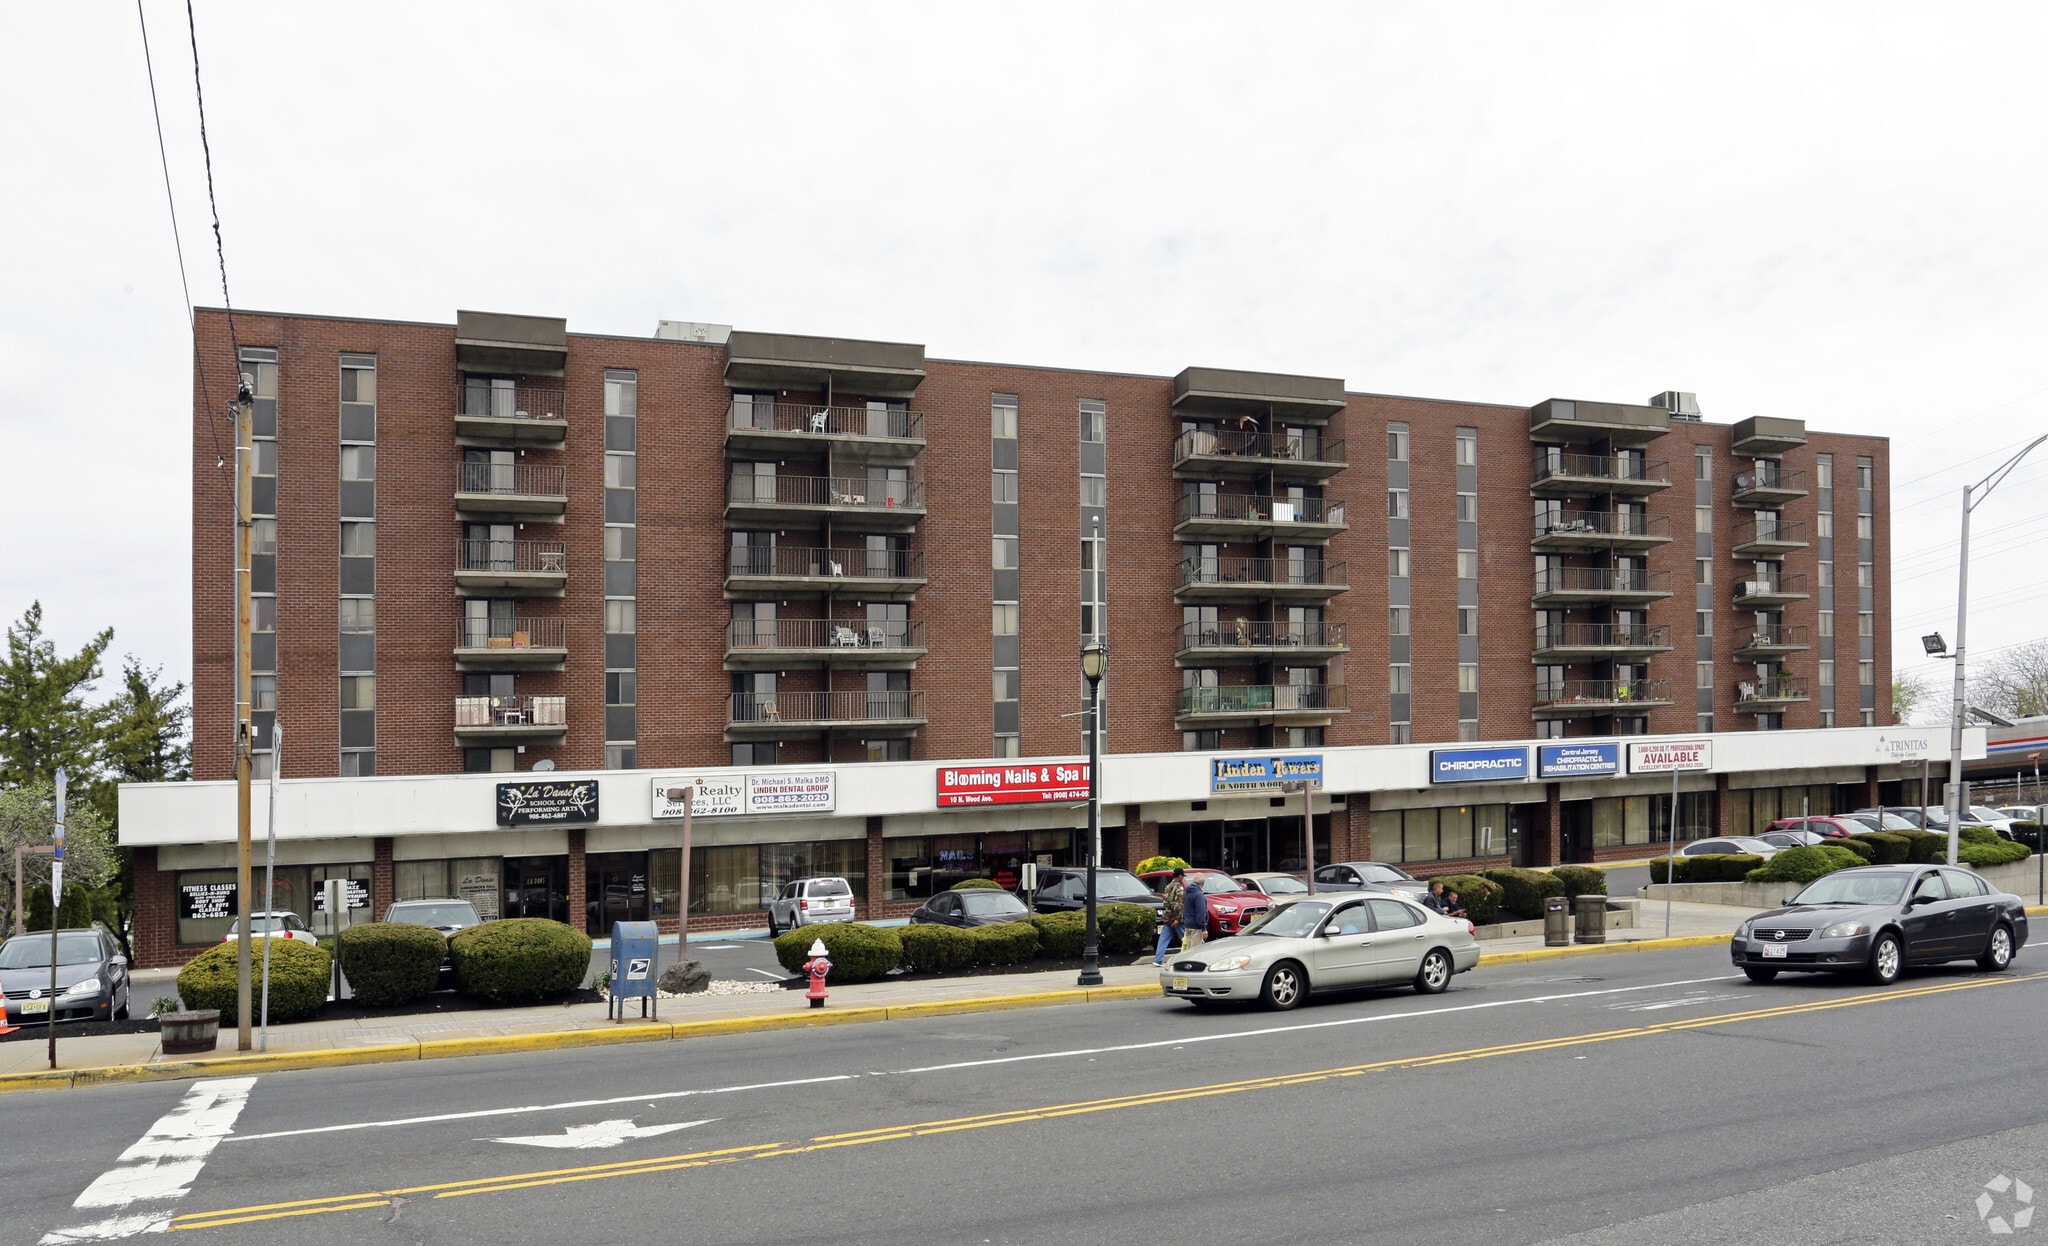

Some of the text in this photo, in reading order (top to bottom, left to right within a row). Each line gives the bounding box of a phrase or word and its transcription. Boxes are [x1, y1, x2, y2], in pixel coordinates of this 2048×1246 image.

[1890, 740, 1928, 751] TRINITAS
[1556, 756, 1598, 764] CHIROPRACTIC
[1644, 752, 1698, 764] AVAILABLE
[1215, 758, 1320, 781] Linden Towers
[1440, 758, 1521, 771] CHIROPRACTIC
[1544, 764, 1589, 772] REHABILITATION
[1005, 768, 1037, 784] Nails
[1040, 768, 1050, 782] &
[1056, 766, 1079, 784] Spa
[523, 785, 573, 798] La Danse
[700, 785, 742, 797] Realty
[780, 785, 804, 793] DENTAL
[754, 794, 827, 804] 908-862-2020
[1053, 791, 1067, 800] (908)
[666, 797, 731, 807] Serces, LLC
[518, 806, 560, 814] PERFORMING
[940, 849, 974, 861] NAILS
[210, 883, 236, 891] CLASSES
